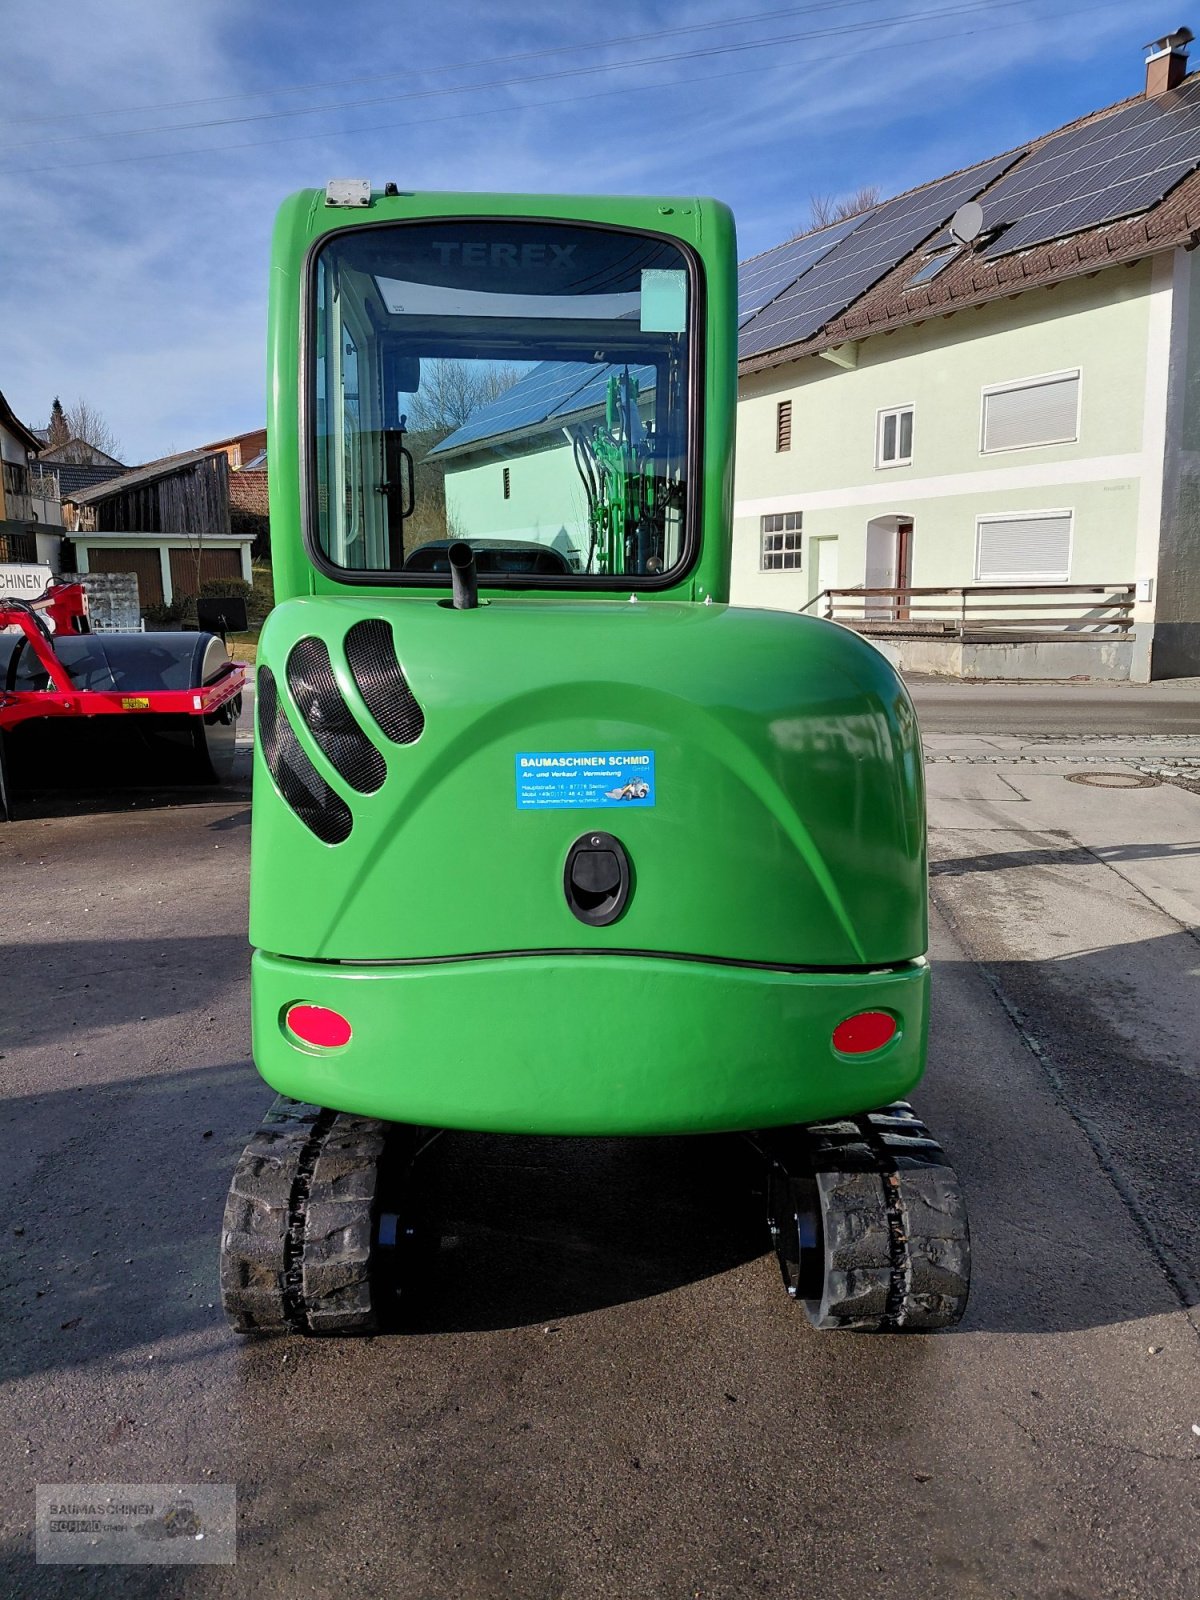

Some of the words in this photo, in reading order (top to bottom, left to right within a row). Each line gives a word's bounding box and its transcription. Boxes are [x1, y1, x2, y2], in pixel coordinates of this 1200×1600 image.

[432, 241, 577, 270] TEREX
[520, 757, 606, 767] BAUMASCHINEN
[608, 755, 650, 765] SCHMID
